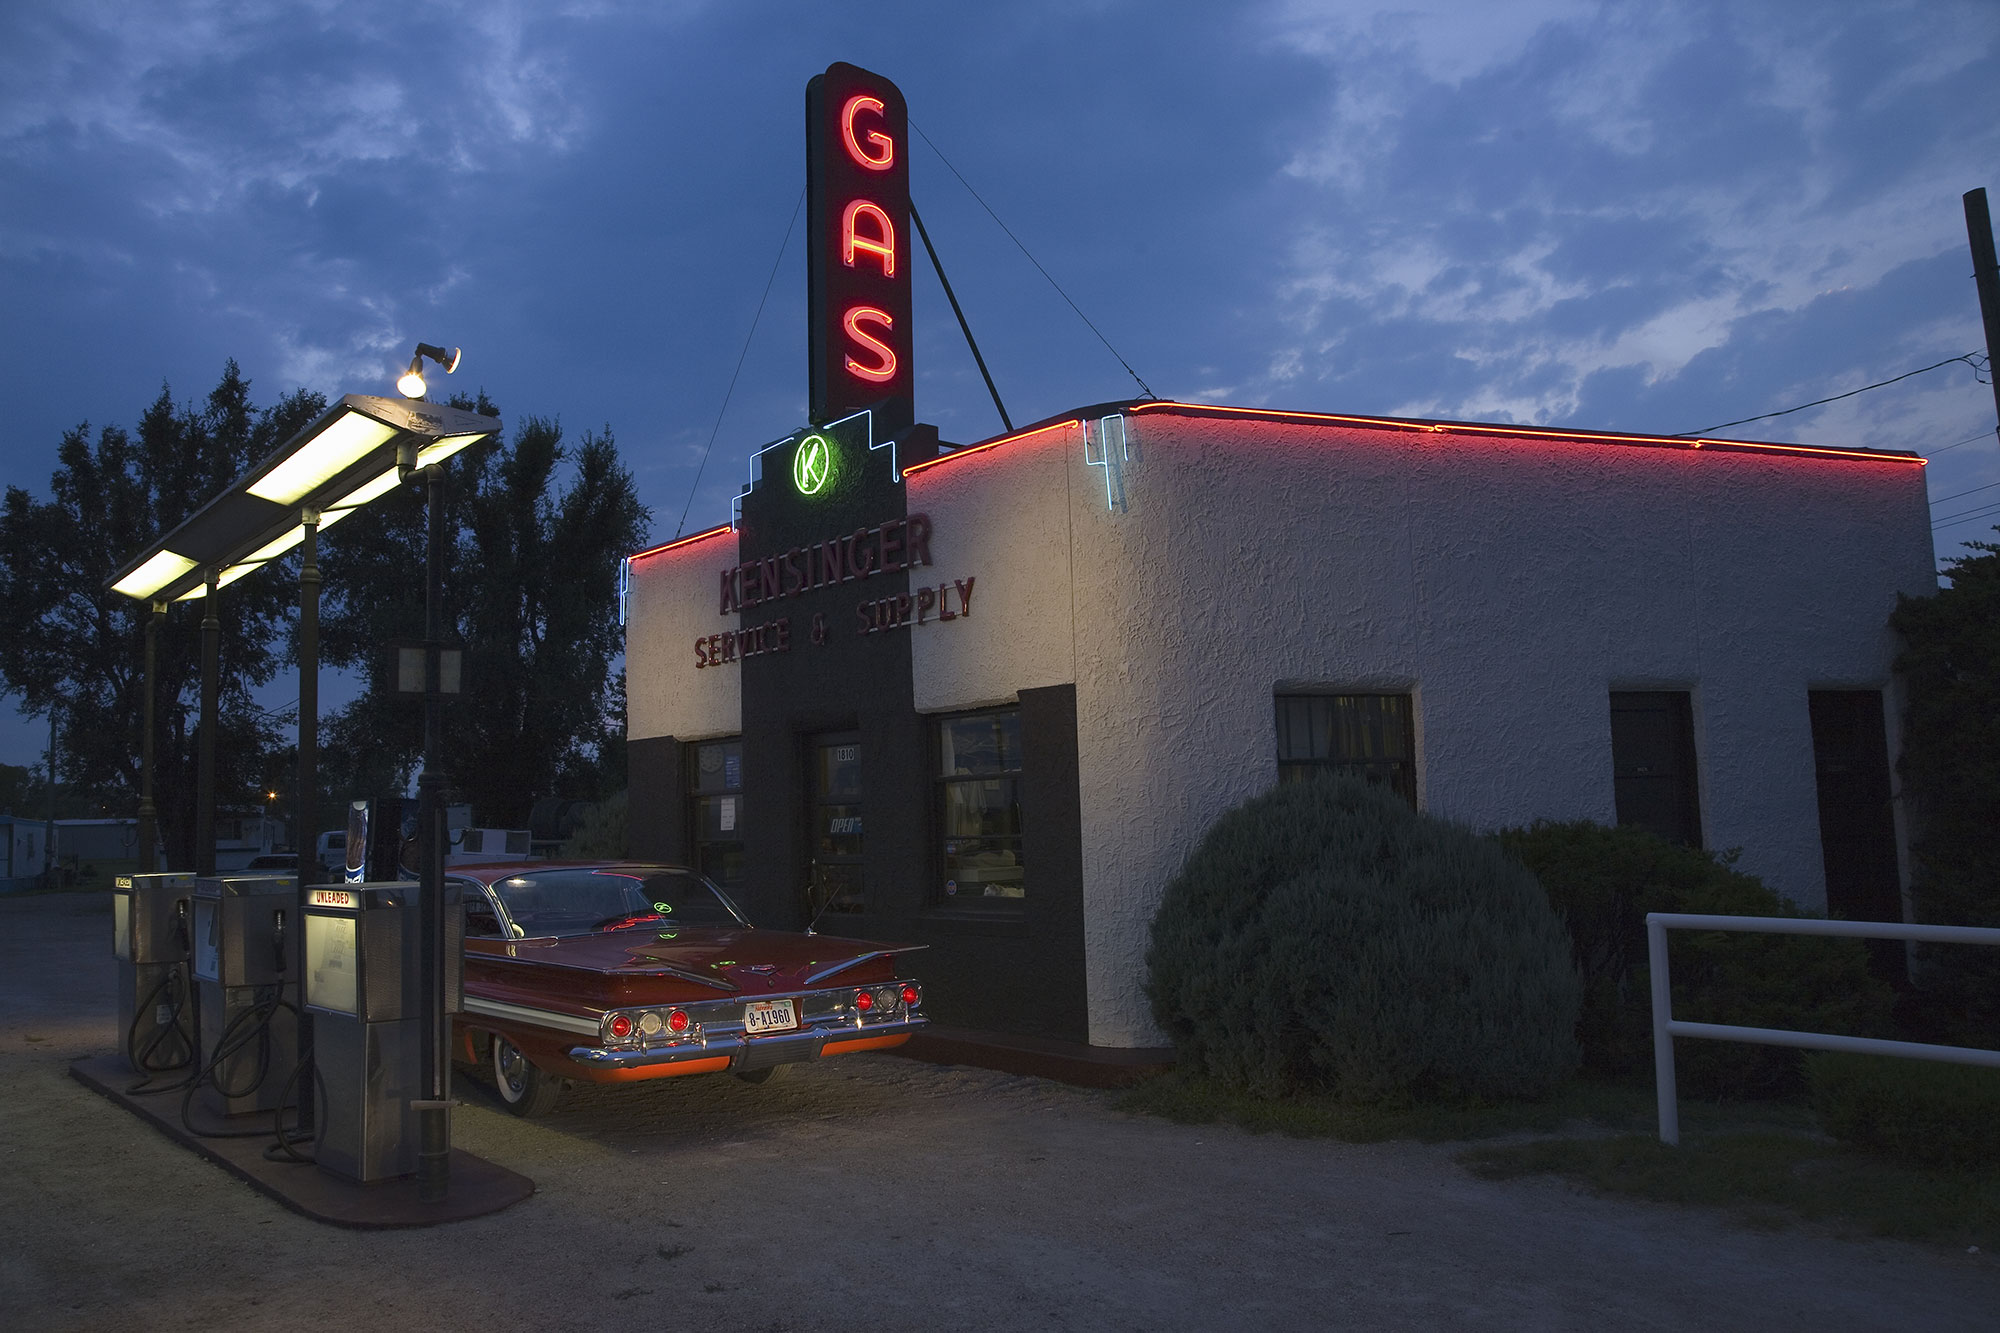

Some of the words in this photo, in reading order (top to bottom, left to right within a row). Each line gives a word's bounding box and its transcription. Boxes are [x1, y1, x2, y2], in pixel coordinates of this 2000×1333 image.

[842, 95, 896, 382] GAS
[801, 443, 820, 488] K
[720, 512, 933, 615] KENSINGER
[695, 617, 791, 668] SERVICE
[810, 612, 829, 647] &
[856, 577, 975, 635] SUPPLY
[830, 817, 855, 833] OPEN
[316, 891, 350, 904] UNLEADED
[748, 1009, 790, 1027] 8-A1960
